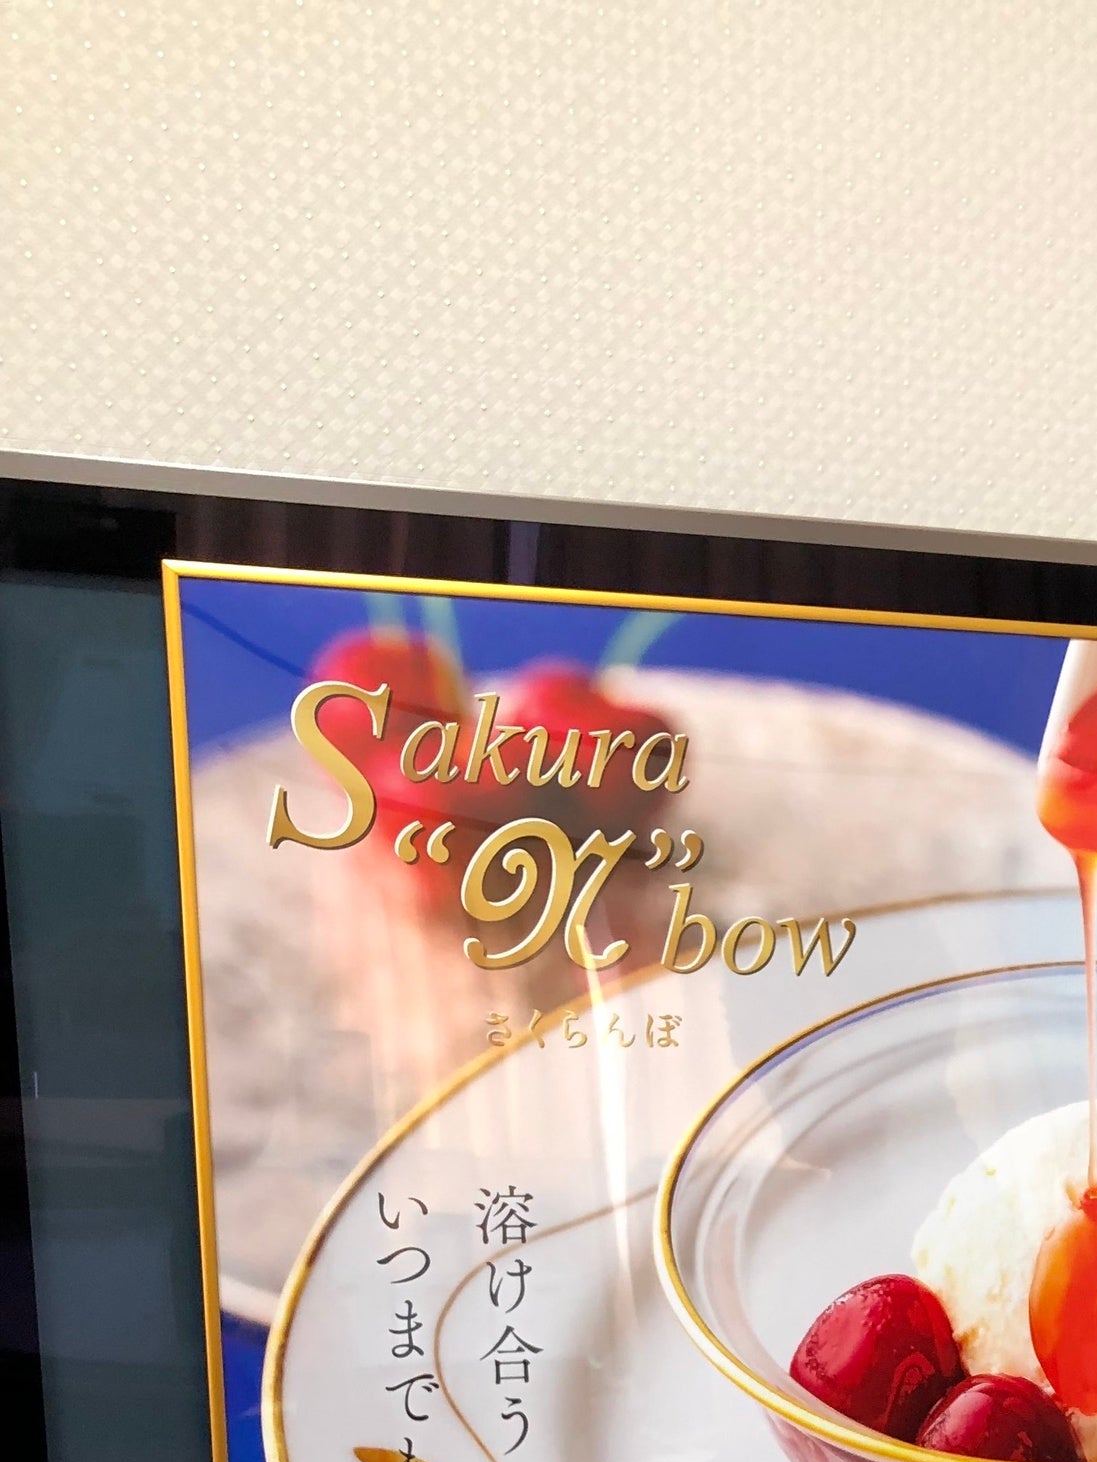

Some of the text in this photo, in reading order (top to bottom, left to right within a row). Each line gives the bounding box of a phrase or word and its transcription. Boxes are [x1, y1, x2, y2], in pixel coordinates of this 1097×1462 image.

[267, 680, 689, 851] Sakura
[660, 883, 856, 976] bow
[484, 1009, 682, 1049] さくらんぼ
